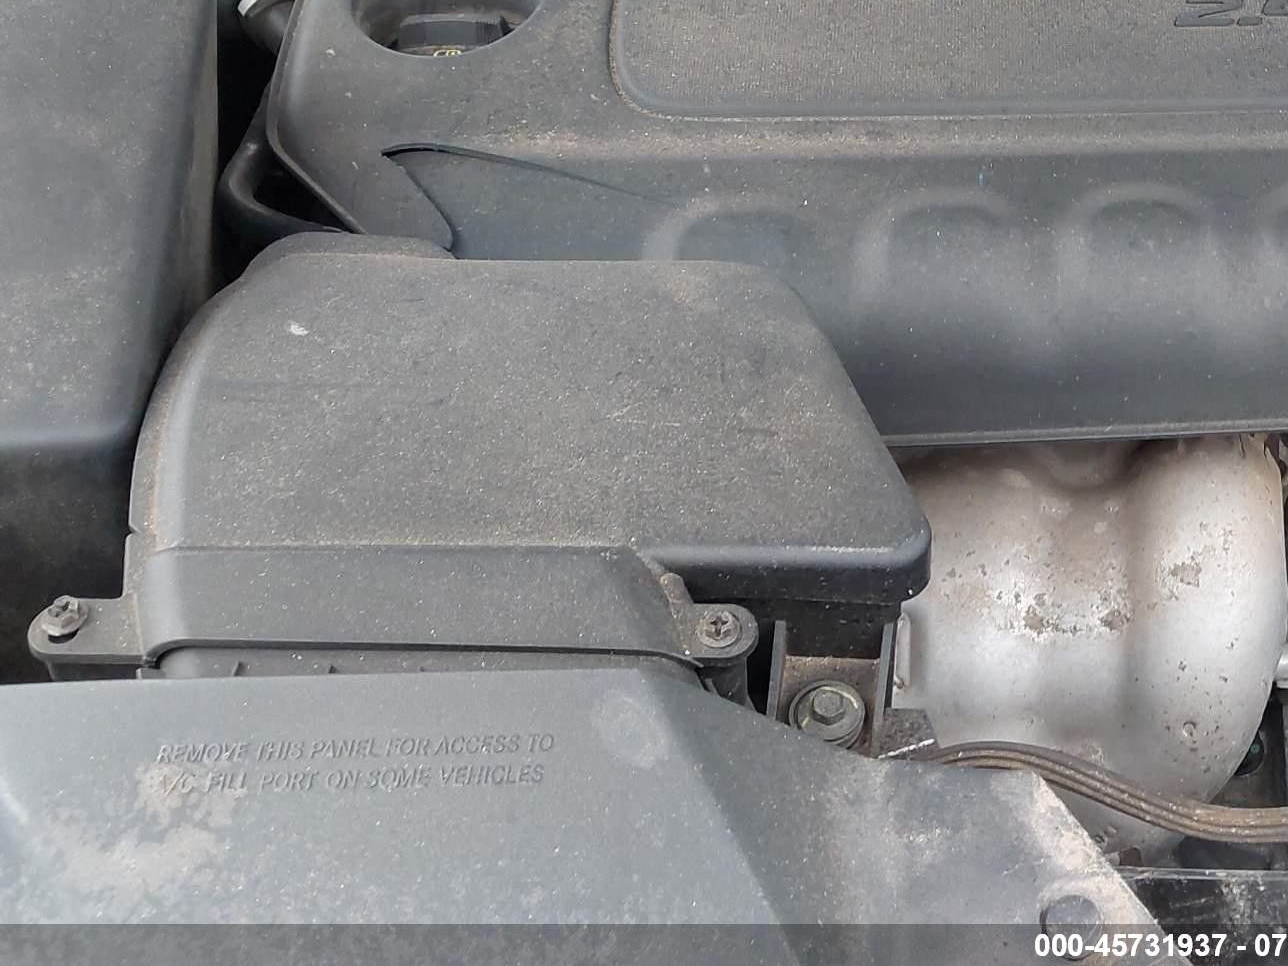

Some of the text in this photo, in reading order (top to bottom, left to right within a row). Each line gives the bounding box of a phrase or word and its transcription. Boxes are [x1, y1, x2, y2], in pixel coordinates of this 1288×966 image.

[156, 733, 555, 763] REMOVE THIS PANEL FOR ACCESS TO
[205, 770, 249, 793] FILL
[259, 769, 320, 793] PORT
[326, 769, 361, 790] ON
[367, 766, 432, 789] SOME
[440, 764, 545, 786] VEHICLES
